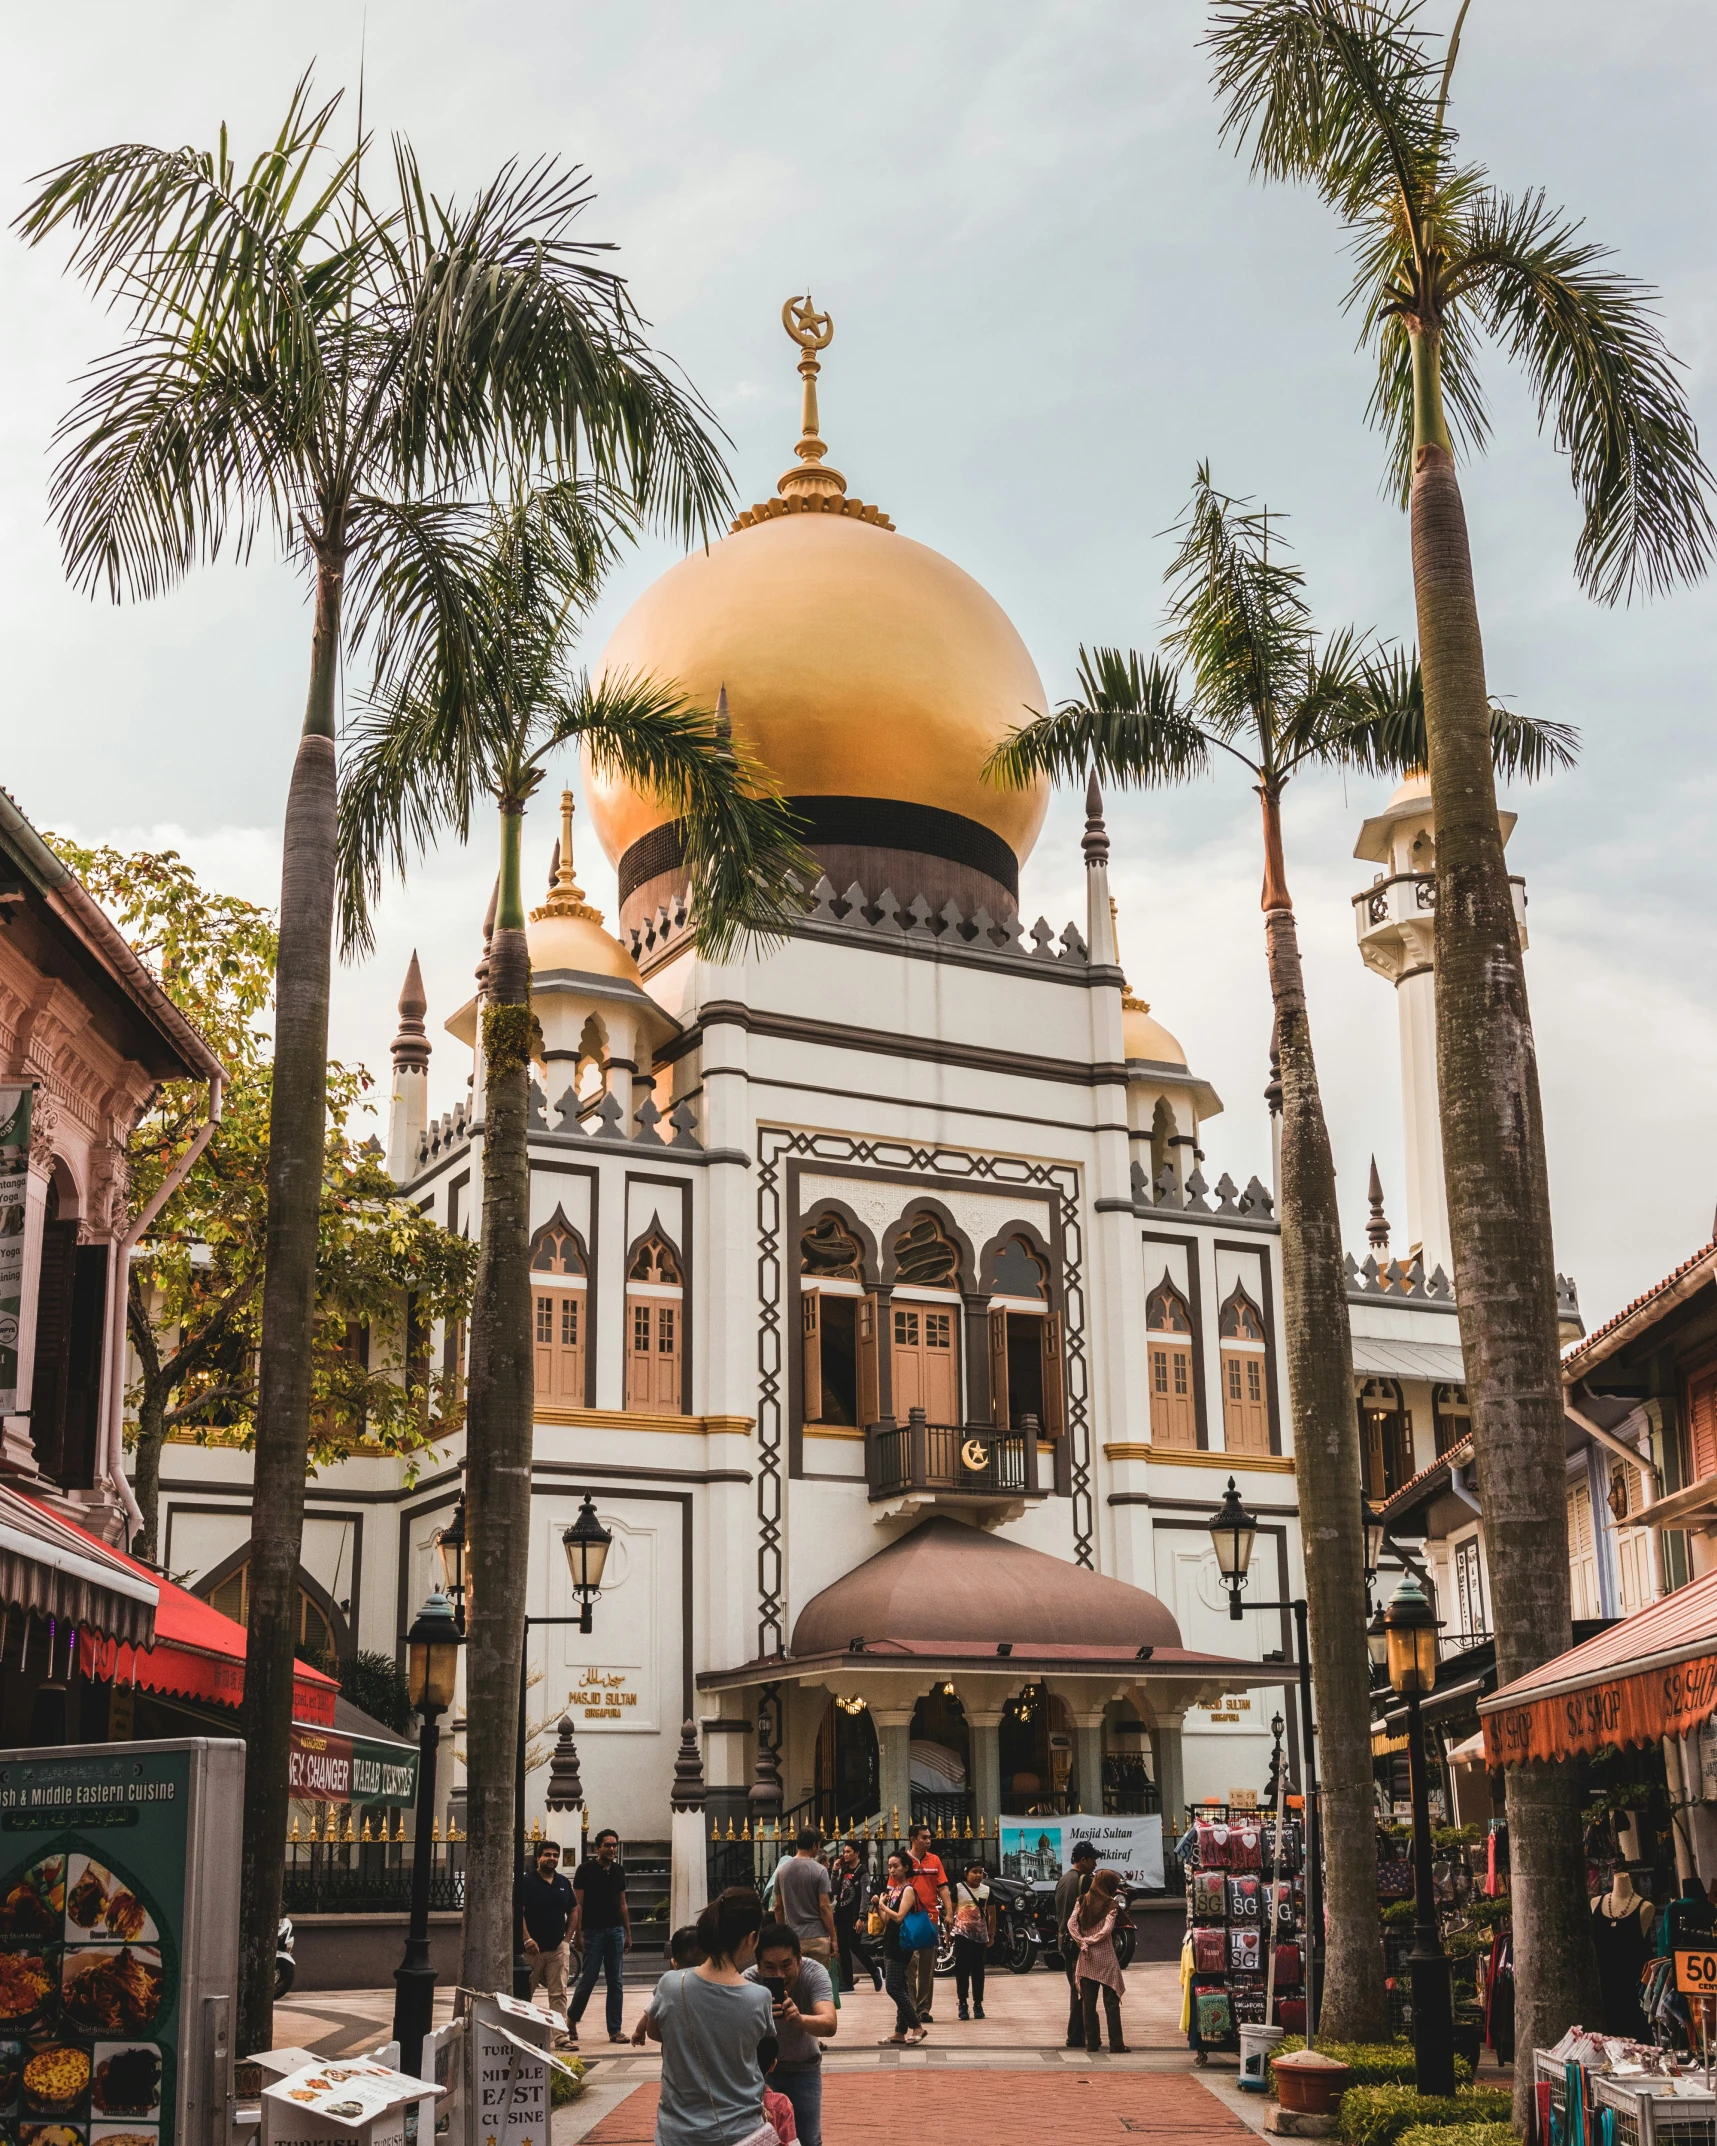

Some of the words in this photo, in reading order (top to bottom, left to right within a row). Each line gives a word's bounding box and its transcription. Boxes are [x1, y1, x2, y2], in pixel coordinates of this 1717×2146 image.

[0, 1119, 15, 1137] oga
[0, 1271, 20, 1282] ining
[569, 1691, 600, 1704] MASJID
[606, 1693, 637, 1705] SULTAN
[1226, 1699, 1250, 1710] SULTAN
[1506, 1712, 1532, 1750] SHOP
[307, 1754, 348, 1791] CHANGER
[353, 1758, 380, 1793] WAHAB
[20, 1790, 27, 1806] &
[31, 1786, 72, 1805] Middle
[76, 1784, 124, 1803] Eastern
[1070, 1828, 1101, 1842] Masjid
[1103, 1828, 1132, 1838] Sultan
[1197, 1894, 1222, 1912] SG
[1234, 1898, 1258, 1915] SG
[1232, 1951, 1257, 1967] SG
[1687, 1956, 1716, 1982] 50
[482, 2043, 543, 2056] TURH
[482, 2111, 544, 2125] CUSINE
